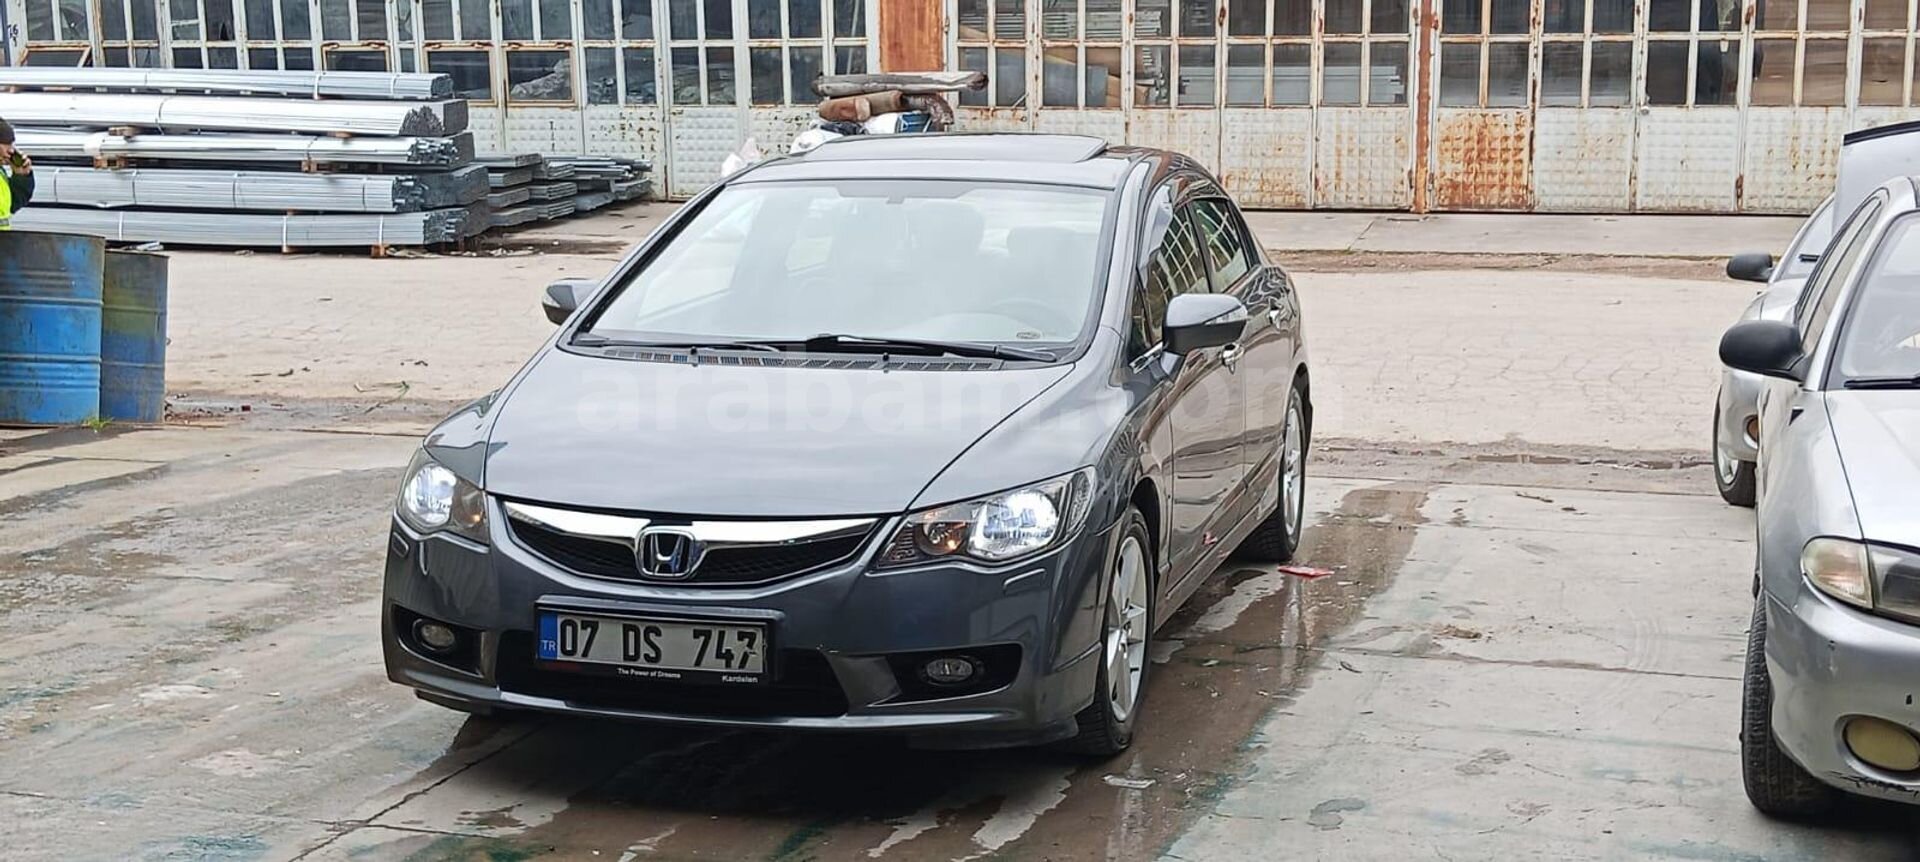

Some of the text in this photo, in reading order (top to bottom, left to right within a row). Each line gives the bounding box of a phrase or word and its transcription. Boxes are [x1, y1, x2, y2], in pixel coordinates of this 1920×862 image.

[540, 639, 556, 651] TR
[560, 619, 757, 669] 07 DS 747
[617, 667, 629, 675] The
[630, 668, 649, 676] Power
[657, 671, 681, 679] Dreams
